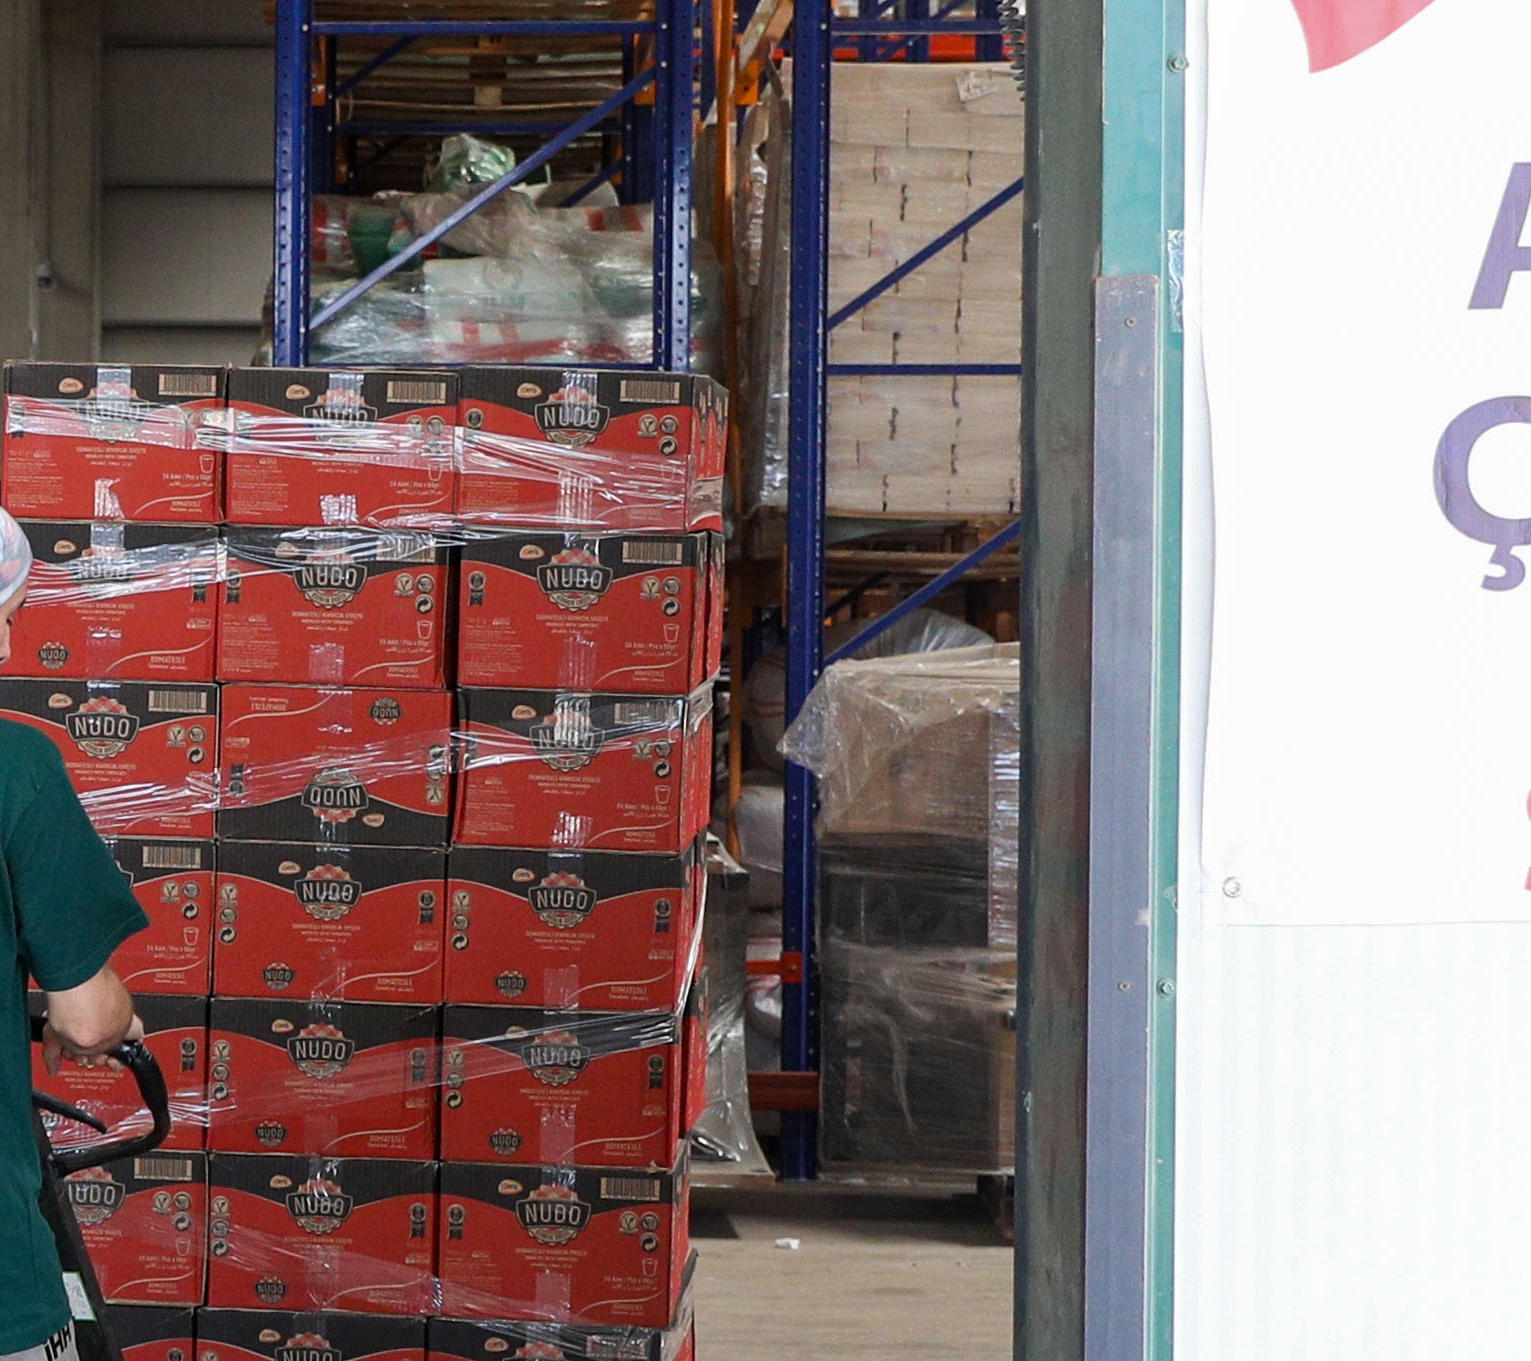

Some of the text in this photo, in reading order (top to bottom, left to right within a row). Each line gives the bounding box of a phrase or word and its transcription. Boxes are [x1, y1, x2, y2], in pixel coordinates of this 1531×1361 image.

[544, 409, 600, 429] NUDO
[301, 567, 358, 588] NUDO
[546, 568, 603, 589] NUDO
[75, 717, 130, 738] NUDO
[310, 787, 361, 806] NUDO
[302, 883, 353, 902] NUDO
[537, 890, 588, 909] NUDO
[295, 1041, 346, 1060] NUDO
[530, 1049, 581, 1067] NUDO
[294, 1196, 344, 1215] NUDO
[525, 1204, 581, 1224] NUDO
